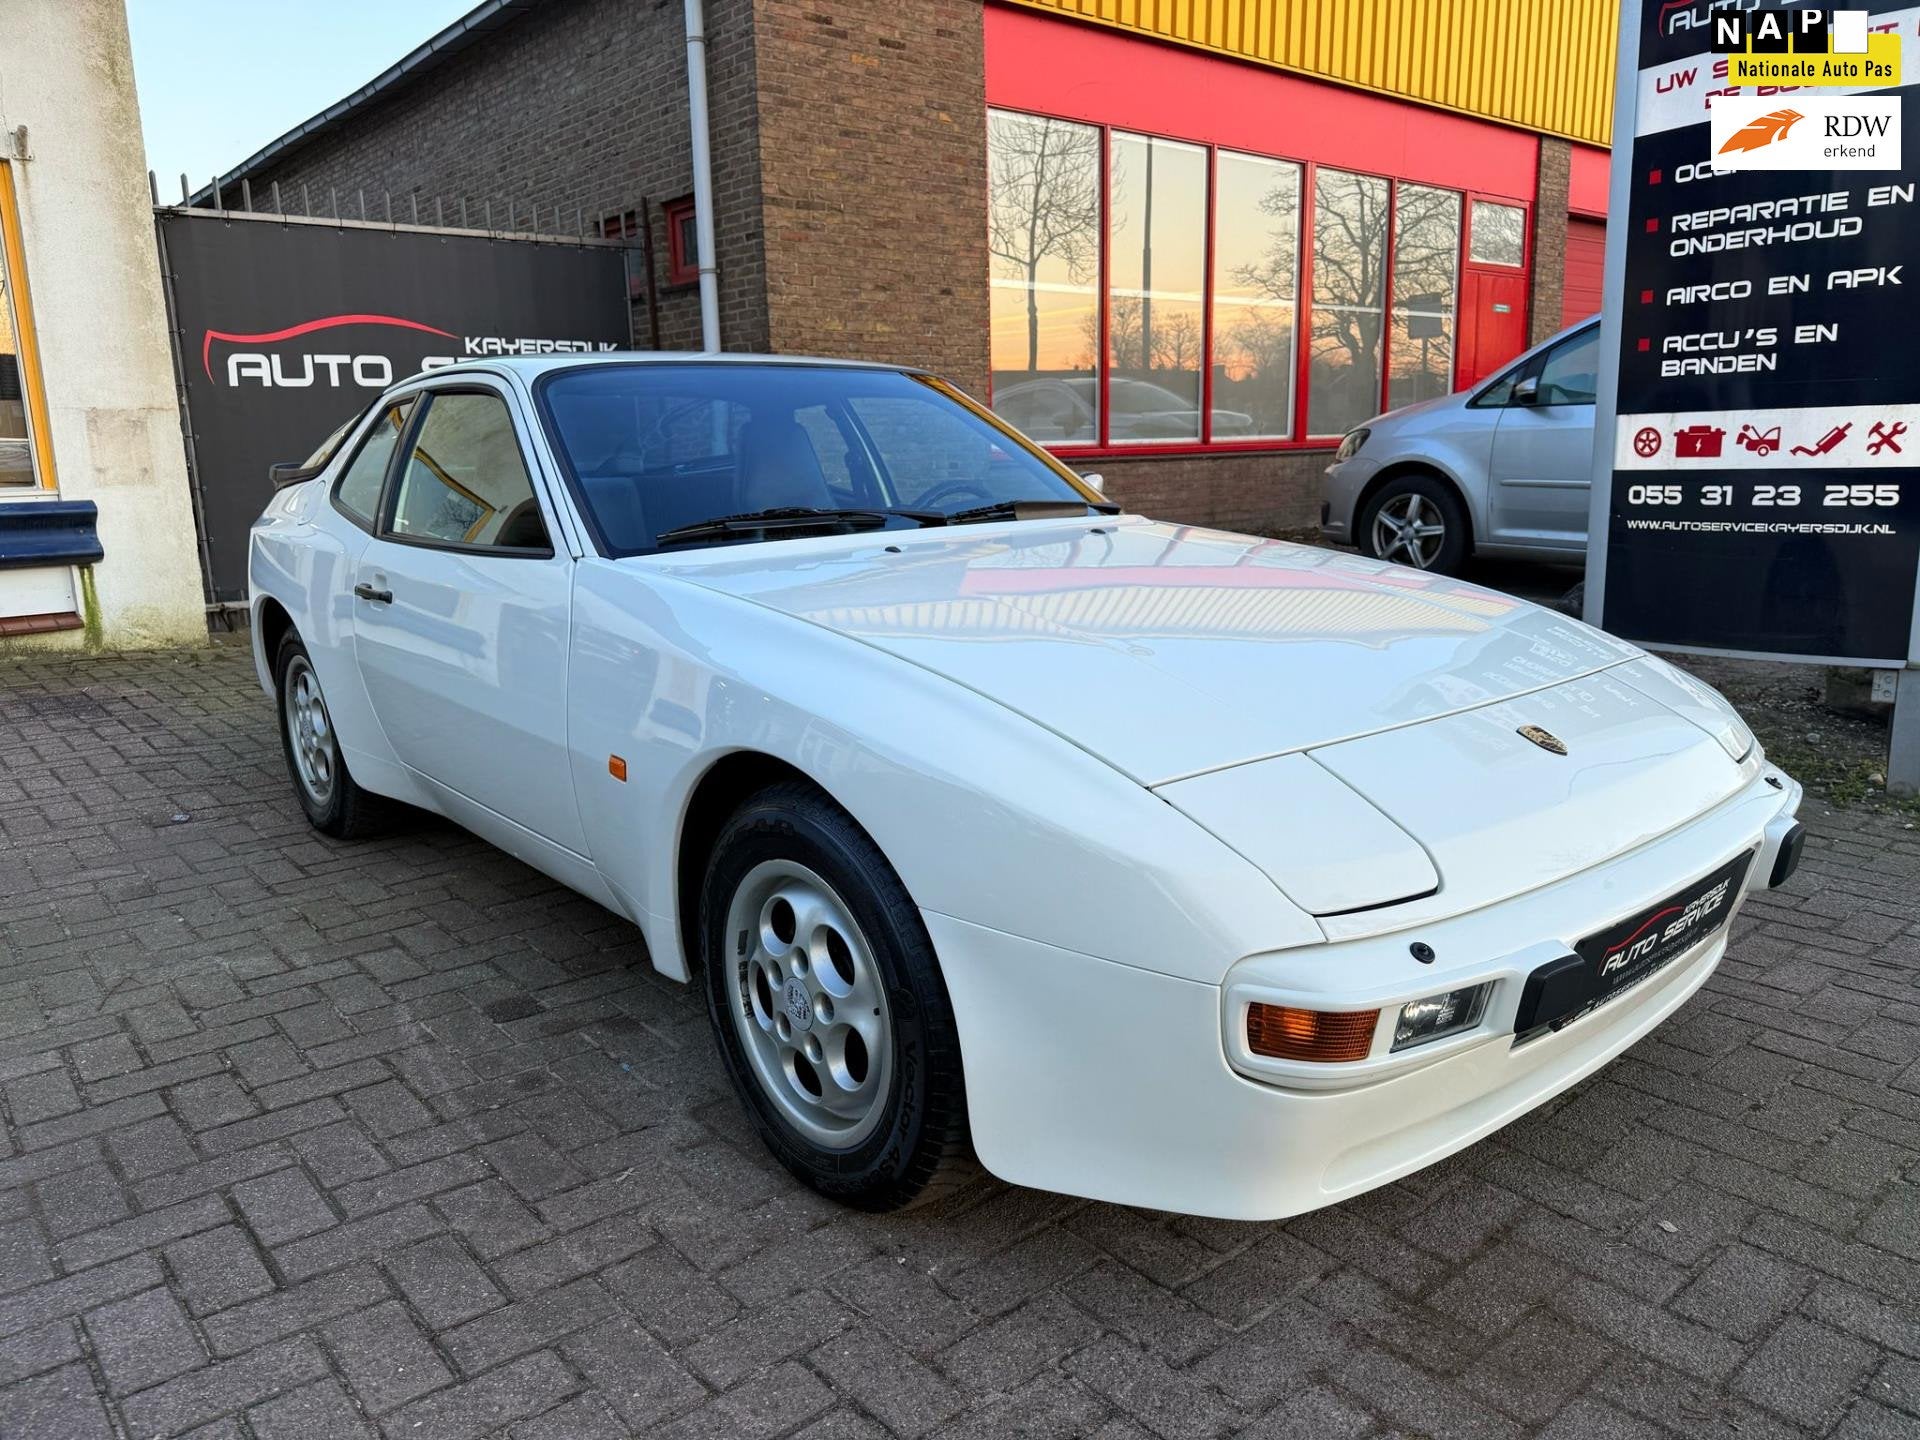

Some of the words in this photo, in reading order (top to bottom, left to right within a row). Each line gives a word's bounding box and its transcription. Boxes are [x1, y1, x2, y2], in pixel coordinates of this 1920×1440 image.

[1656, 67, 1698, 94] UW
[1671, 191, 1850, 233] REPARATIE
[1867, 183, 1915, 207] EN
[1670, 216, 1863, 257] ONDERHOUD
[1666, 280, 1751, 306] AIRCO
[1768, 274, 1810, 295] EN
[1827, 265, 1903, 290] APK
[1663, 327, 1778, 353] ACCU'S
[1794, 323, 1839, 344] EN
[227, 353, 393, 387] AUTO
[1660, 353, 1777, 377] BANDEN
[1628, 485, 1682, 505] 055
[1700, 485, 1734, 505] 31
[1751, 485, 1801, 506] 23
[1823, 484, 1900, 506] 255
[1626, 519, 1896, 534] WWW.AUTOSERVICEKAYERSDIJK.NL
[1602, 932, 1658, 976] AUTO
[1661, 888, 1727, 943] SERVICE
